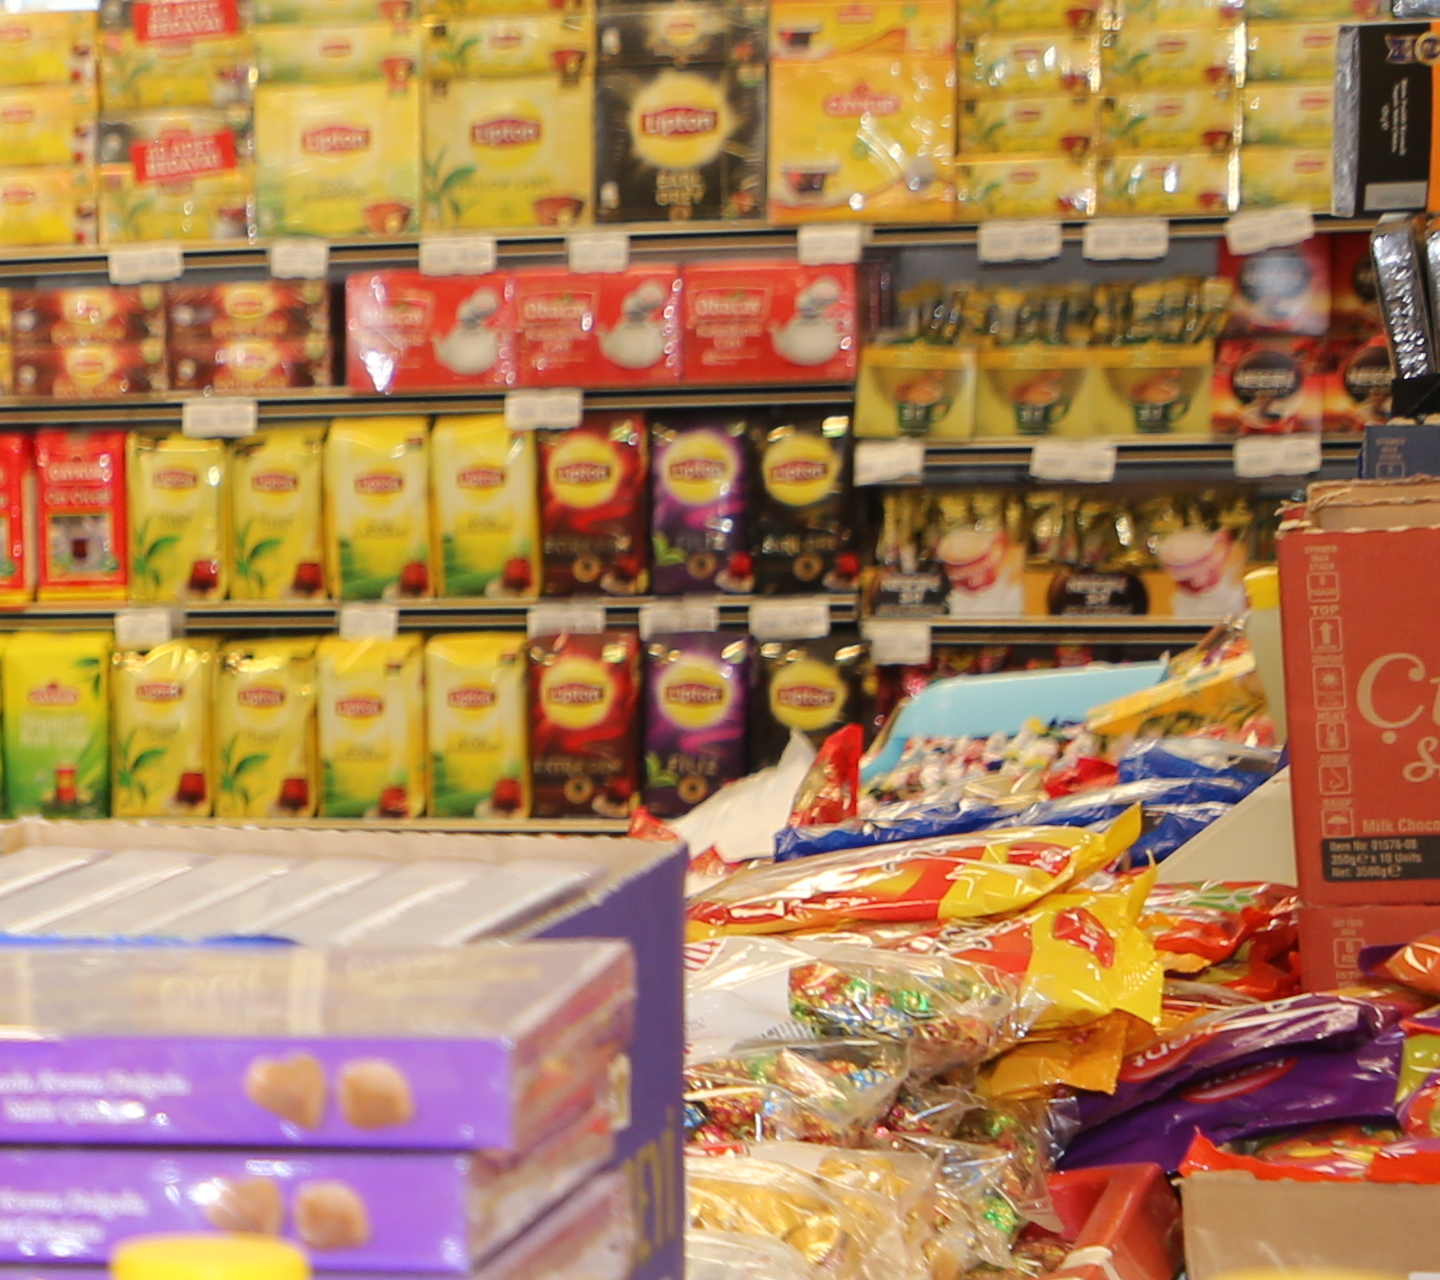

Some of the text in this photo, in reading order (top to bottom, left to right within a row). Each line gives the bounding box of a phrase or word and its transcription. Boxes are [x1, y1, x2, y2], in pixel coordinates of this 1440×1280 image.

[643, 112, 718, 137] Lipton
[473, 122, 540, 146] Lipton
[558, 465, 611, 483] Lipton
[1310, 606, 1340, 616] TOP
[550, 686, 604, 704] Lipton
[667, 686, 723, 705] Lipton
[1362, 819, 1394, 833] Milk
